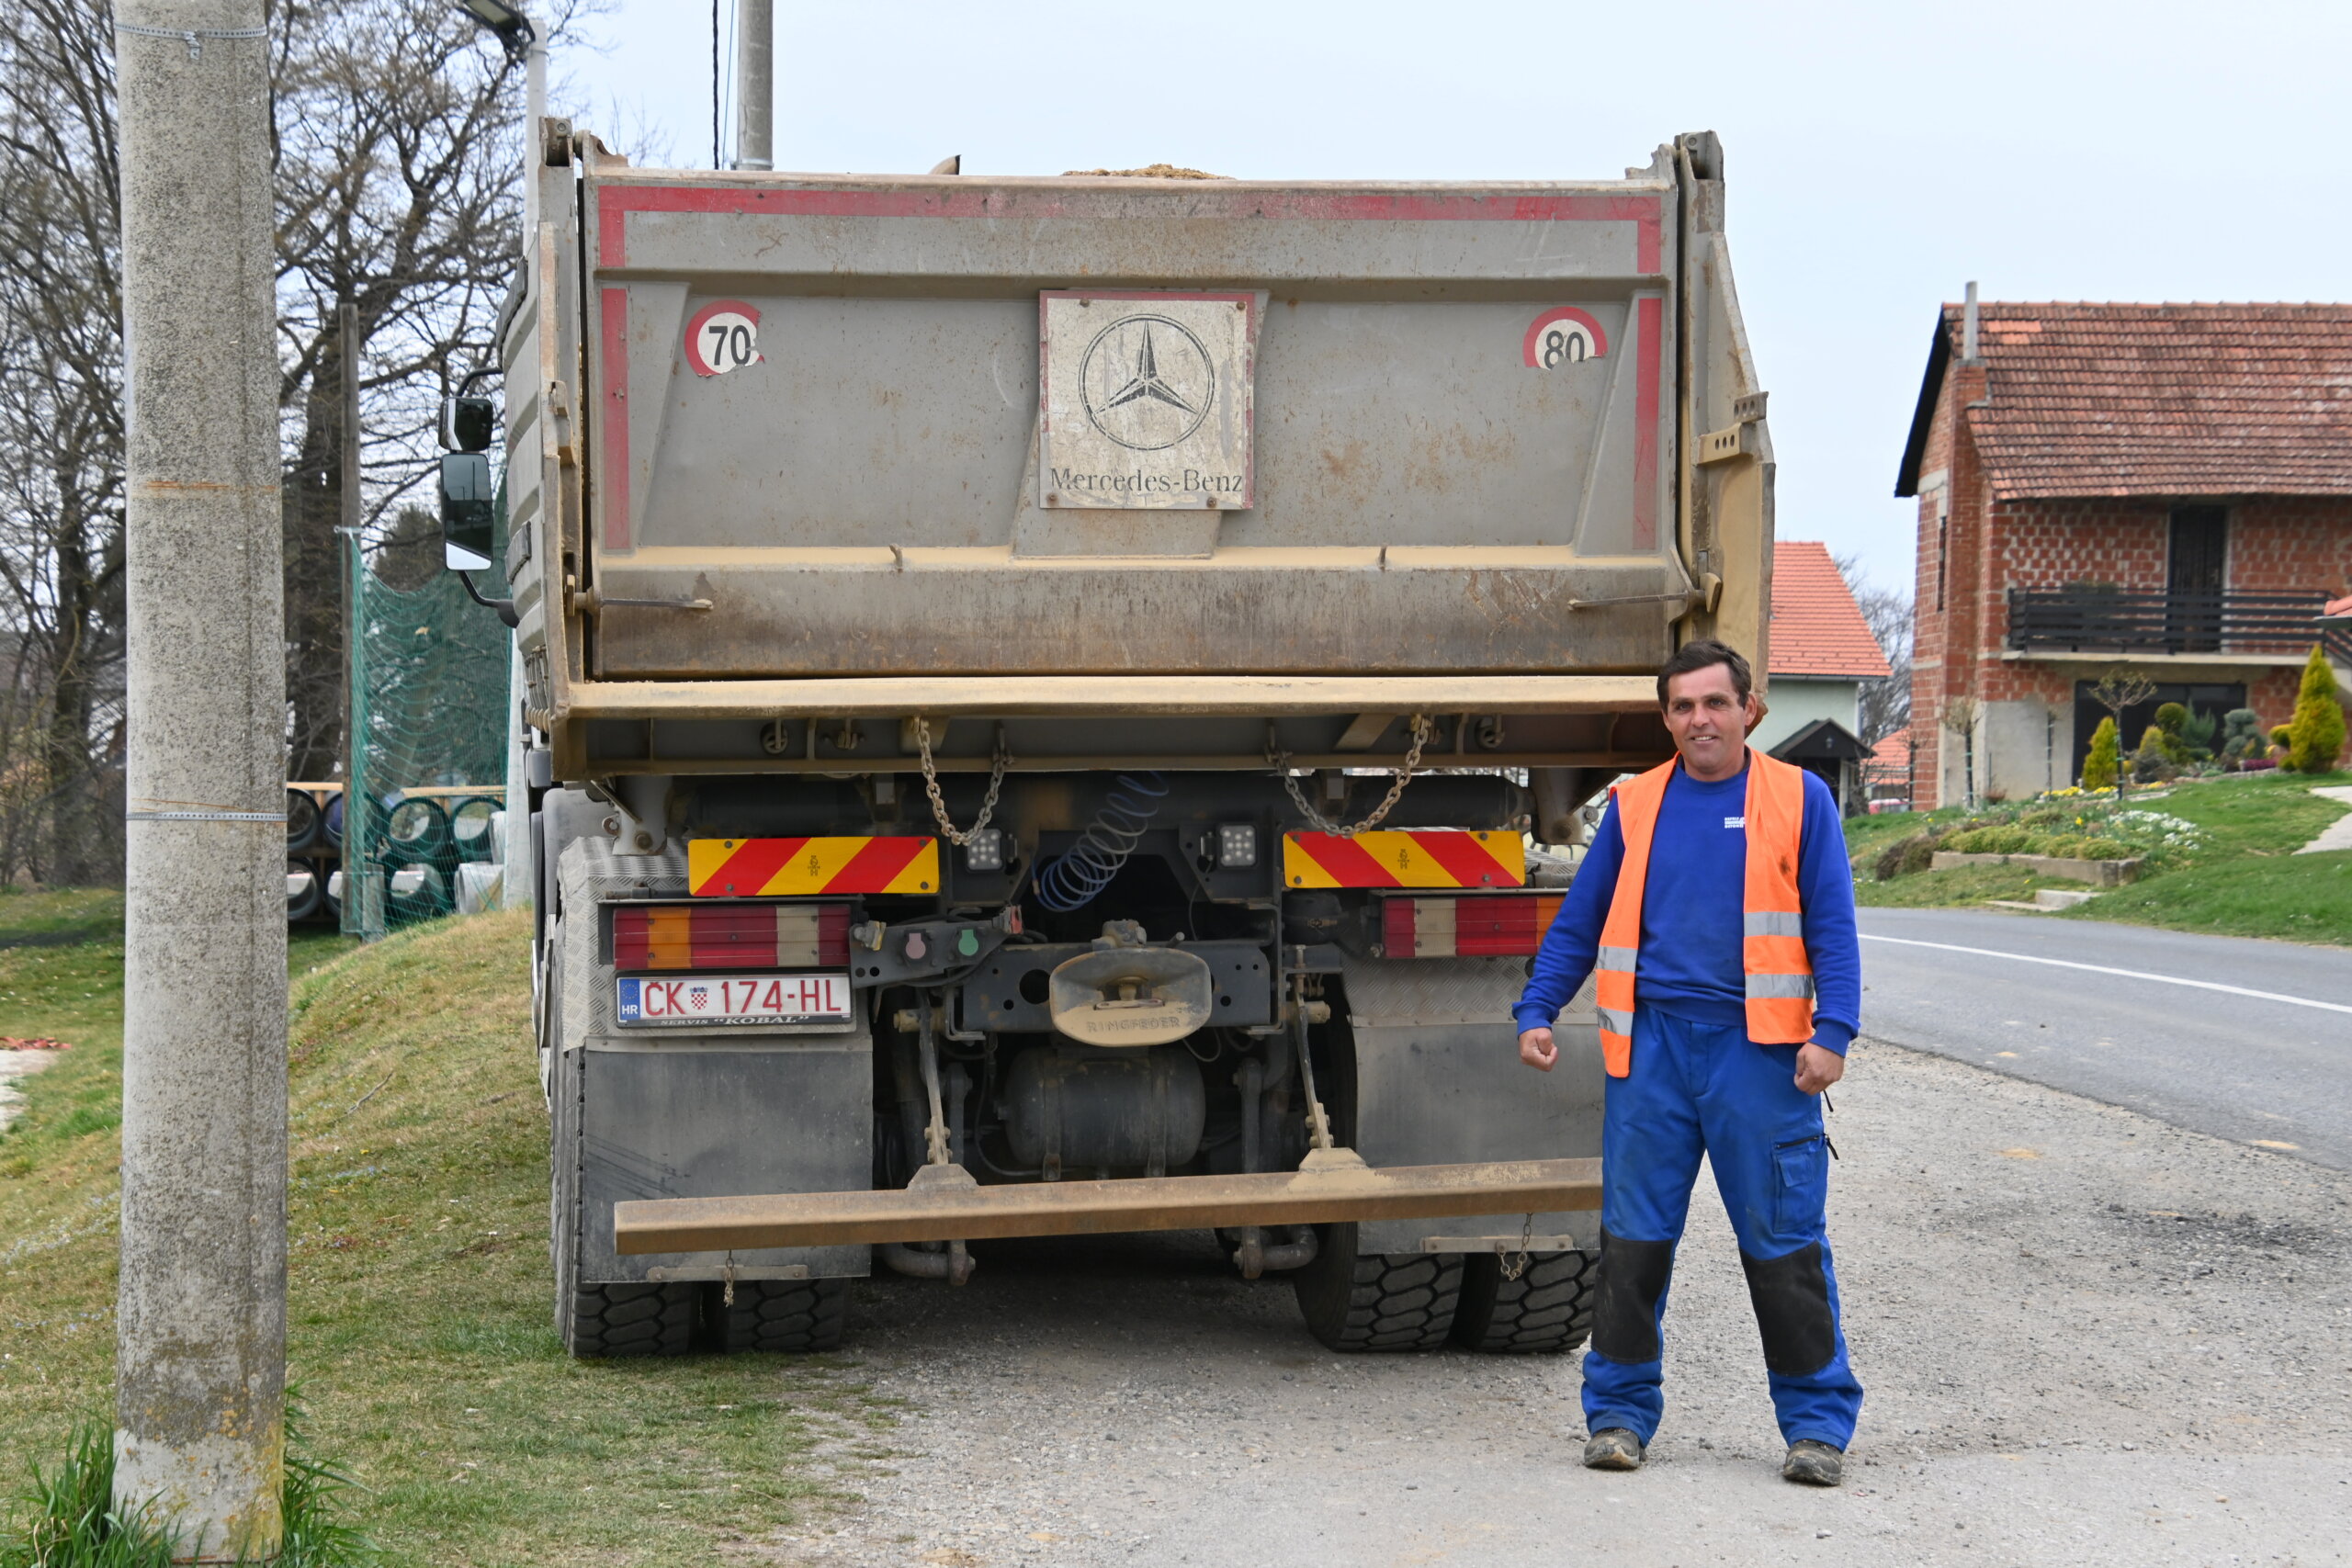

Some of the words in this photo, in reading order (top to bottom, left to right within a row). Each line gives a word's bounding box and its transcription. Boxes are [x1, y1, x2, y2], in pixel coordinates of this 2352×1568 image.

[708, 324, 752, 366] 70
[1544, 330, 1586, 370] 80
[1050, 468, 1243, 493] Mercedes-Benz
[621, 1004, 639, 1015] HR
[644, 981, 687, 1017] ČK
[720, 979, 842, 1014] 174-HL
[1086, 1016, 1182, 1032] RINGFEDER
